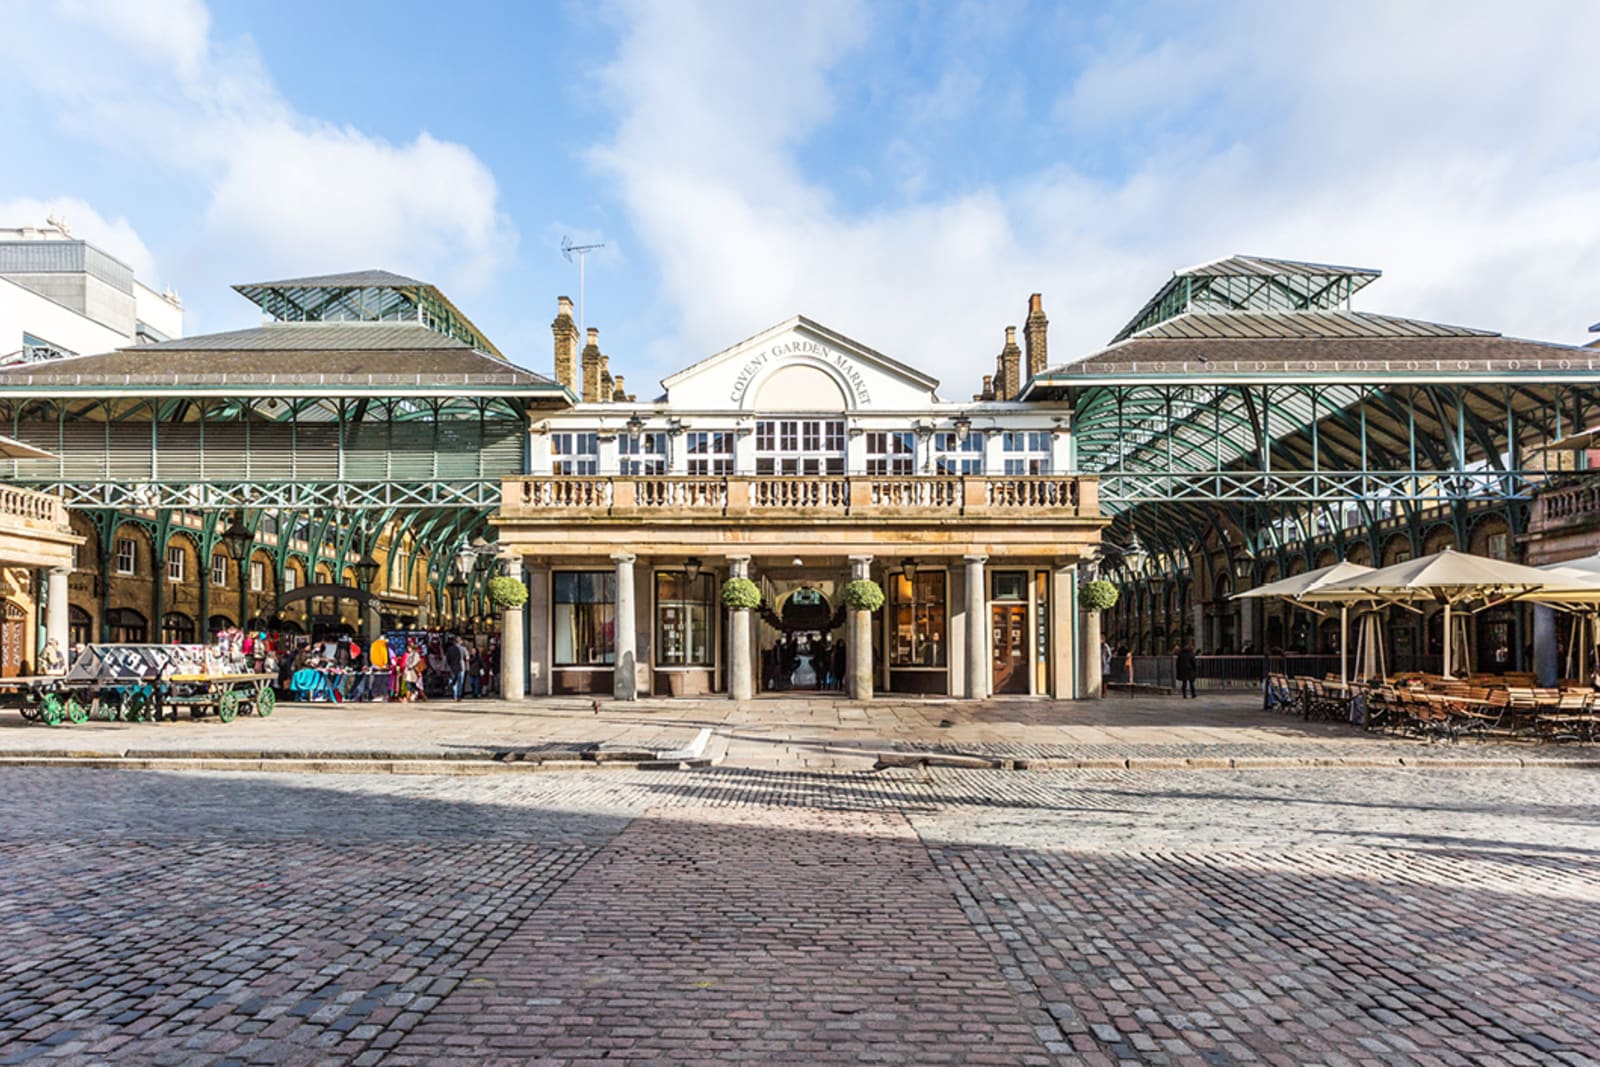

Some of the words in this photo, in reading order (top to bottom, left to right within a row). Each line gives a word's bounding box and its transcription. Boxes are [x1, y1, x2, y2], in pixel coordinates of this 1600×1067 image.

[730, 352, 769, 403] COVENT
[771, 341, 831, 358] GARDEN
[834, 355, 871, 405] MARKET
